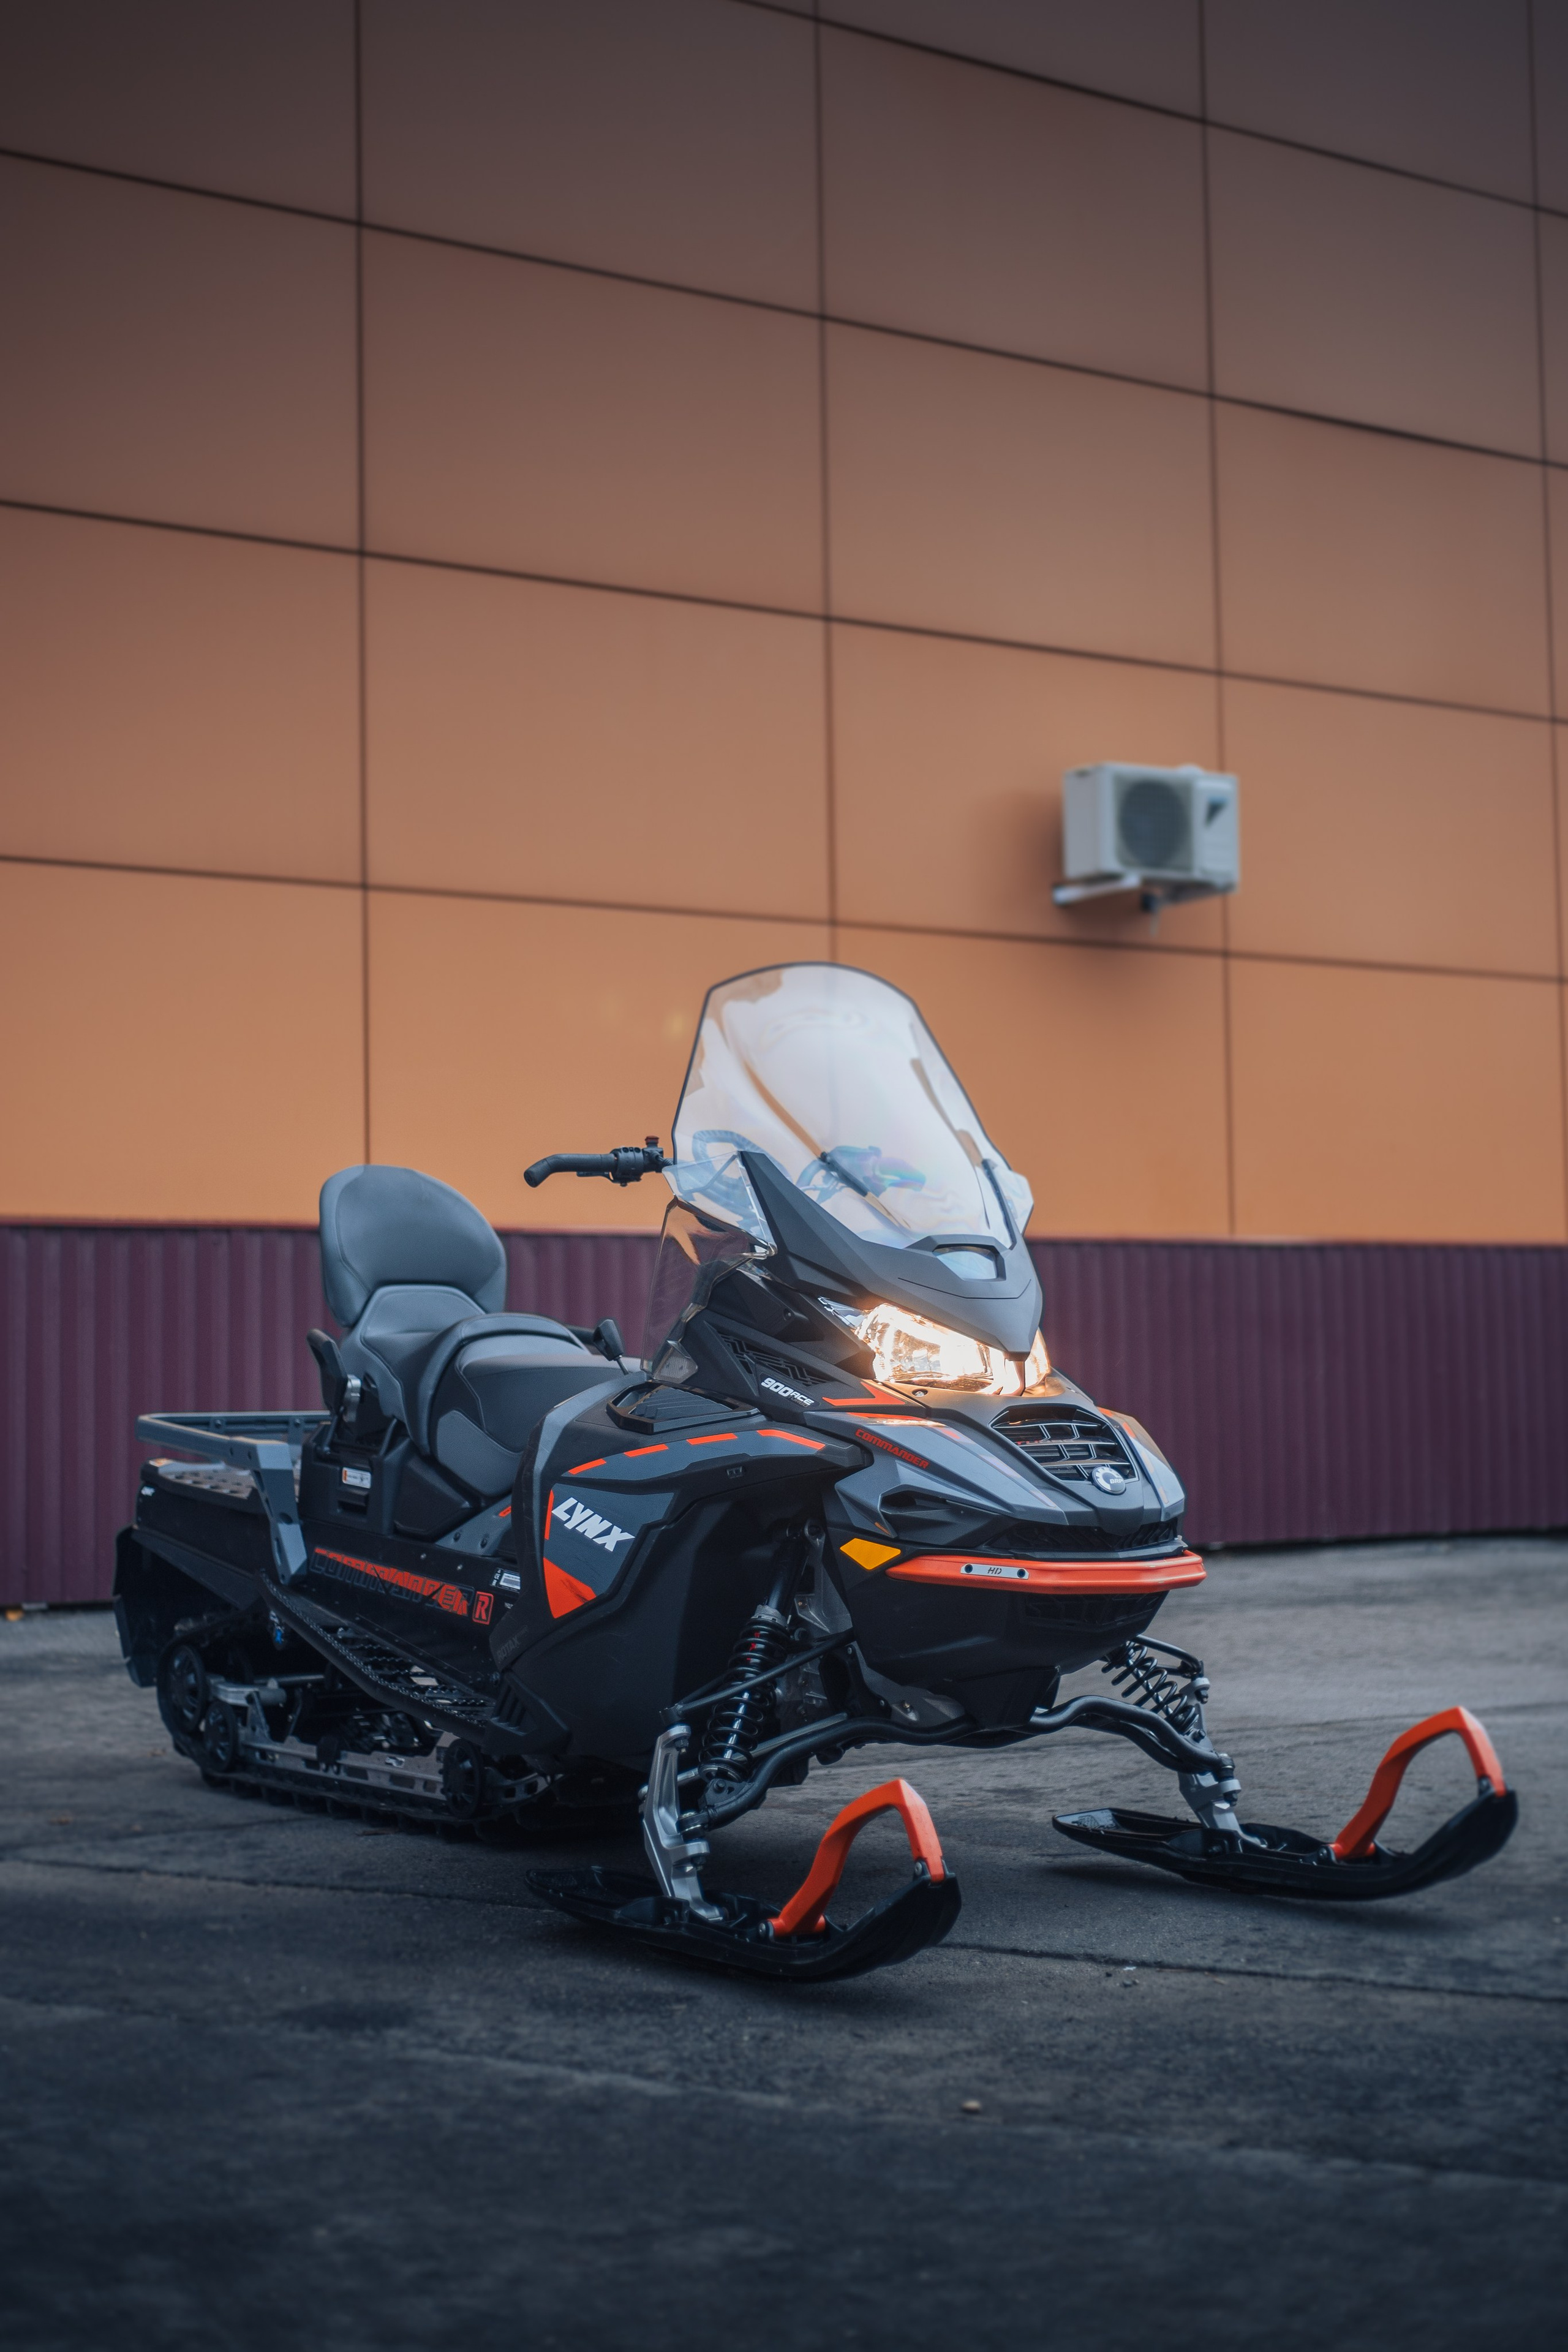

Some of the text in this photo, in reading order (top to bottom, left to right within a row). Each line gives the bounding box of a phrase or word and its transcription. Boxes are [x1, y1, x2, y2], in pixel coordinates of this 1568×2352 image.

[855, 1428, 929, 1469] COMMANDER
[551, 1497, 636, 1552] LYNX
[309, 1547, 491, 1622] COMMANDER R
